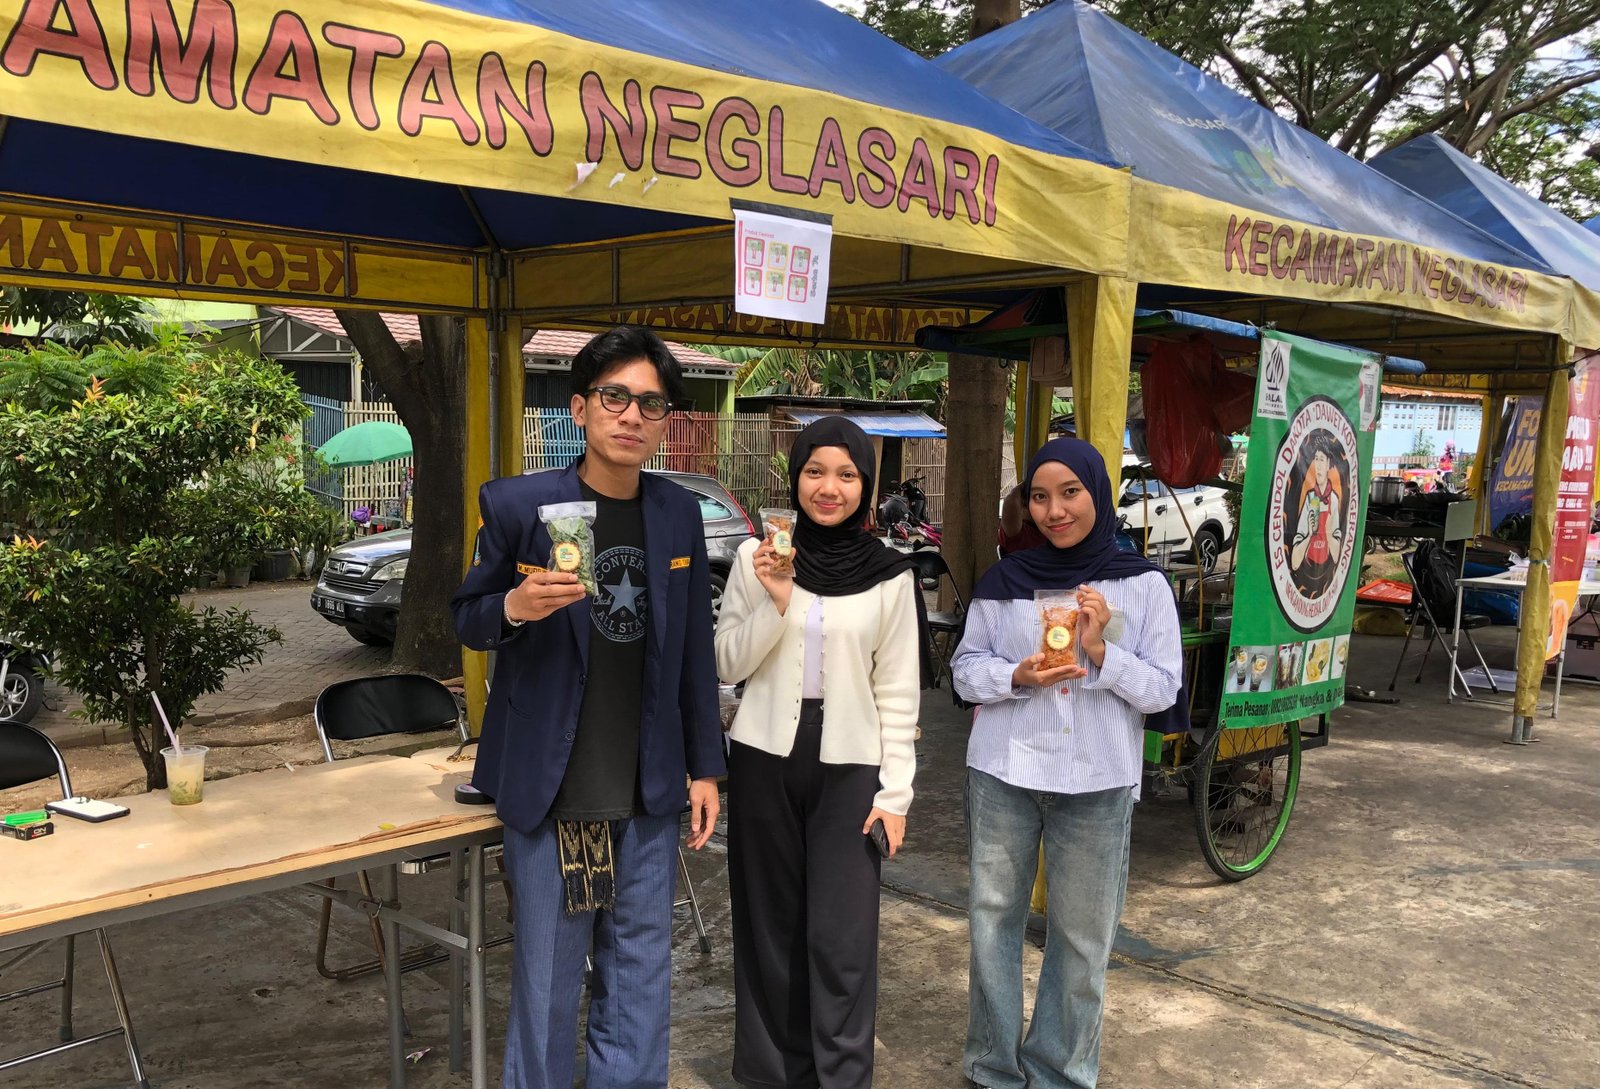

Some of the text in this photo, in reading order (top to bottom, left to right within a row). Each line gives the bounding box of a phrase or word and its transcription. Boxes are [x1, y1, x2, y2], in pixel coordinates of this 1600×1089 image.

[579, 71, 999, 227] NEGLASARI
[1224, 214, 1530, 314] KECAMATAN NEGLASARI
[1281, 409, 1312, 465] DAKOTA
[1272, 469, 1286, 542] CENDOL
[595, 555, 647, 581] CONVER
[1273, 547, 1284, 570] ES
[597, 610, 615, 631] ALL
